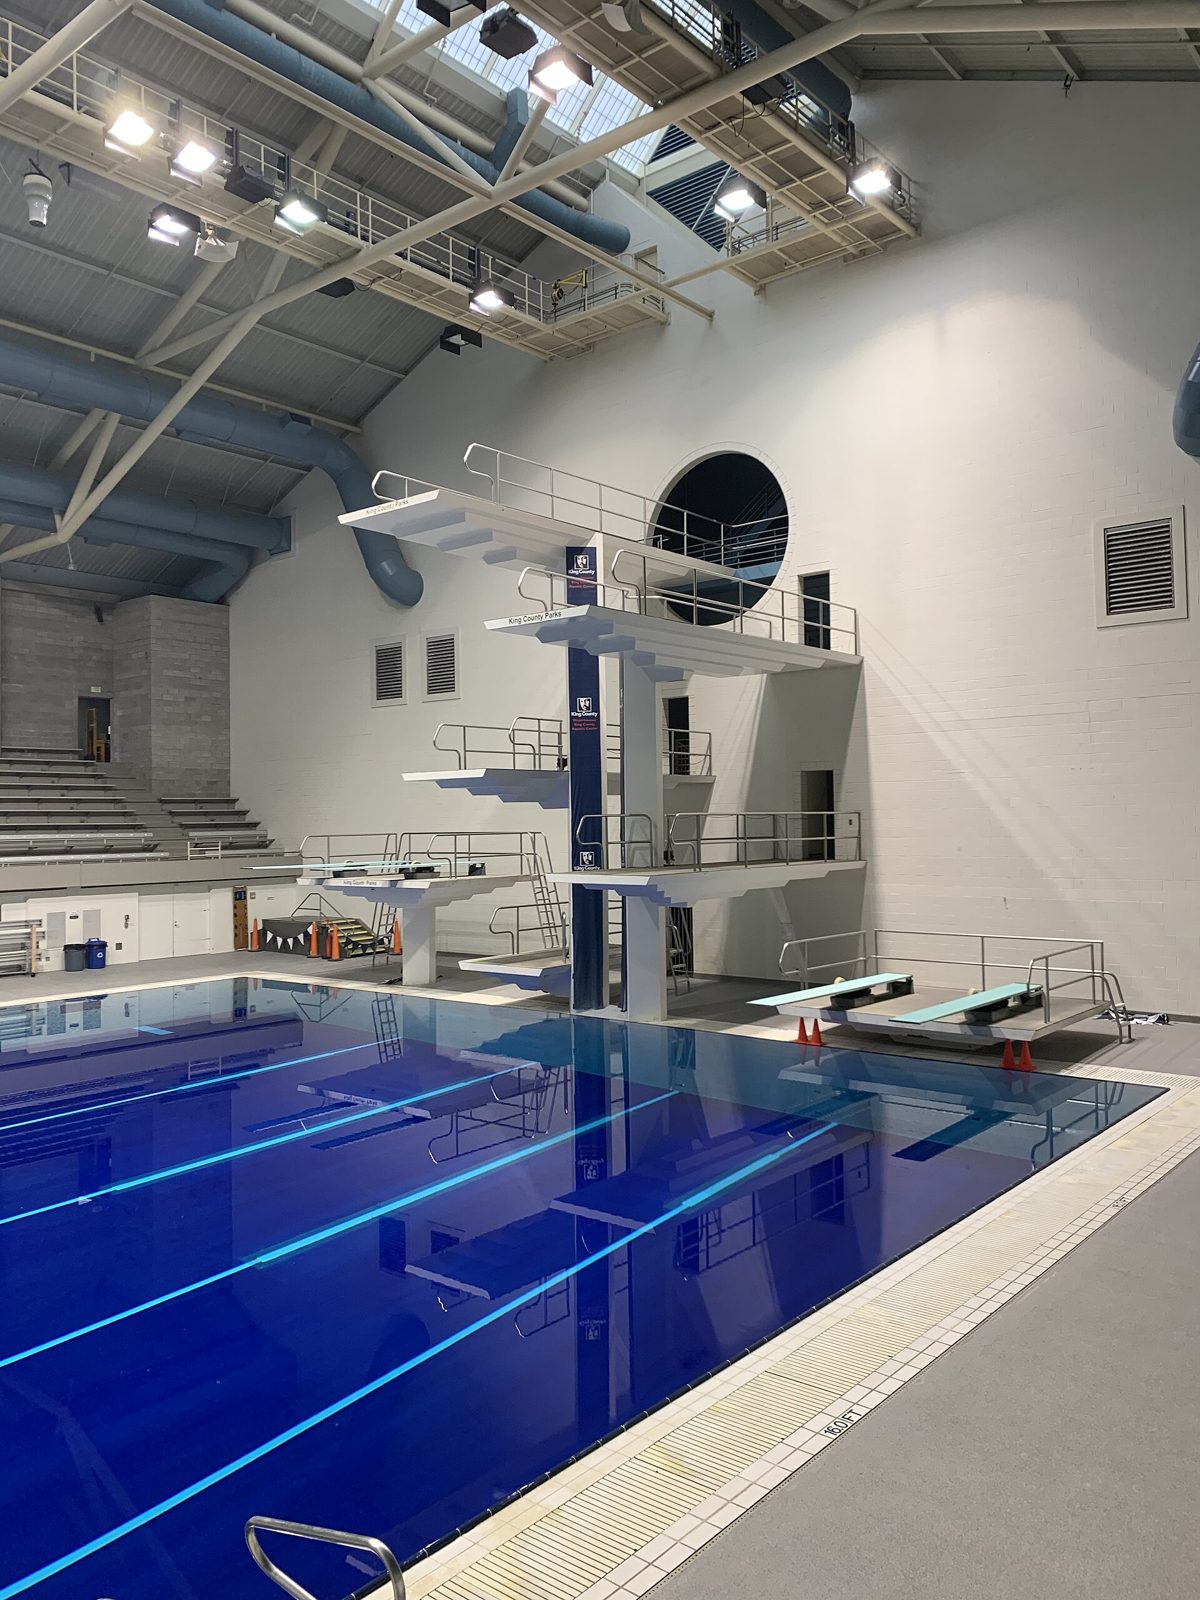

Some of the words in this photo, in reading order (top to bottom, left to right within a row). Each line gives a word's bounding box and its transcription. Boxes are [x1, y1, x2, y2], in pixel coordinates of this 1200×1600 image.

[508, 617, 522, 625] King
[522, 613, 543, 623] County
[545, 611, 562, 619] Parks
[841, 1409, 863, 1423] FT
